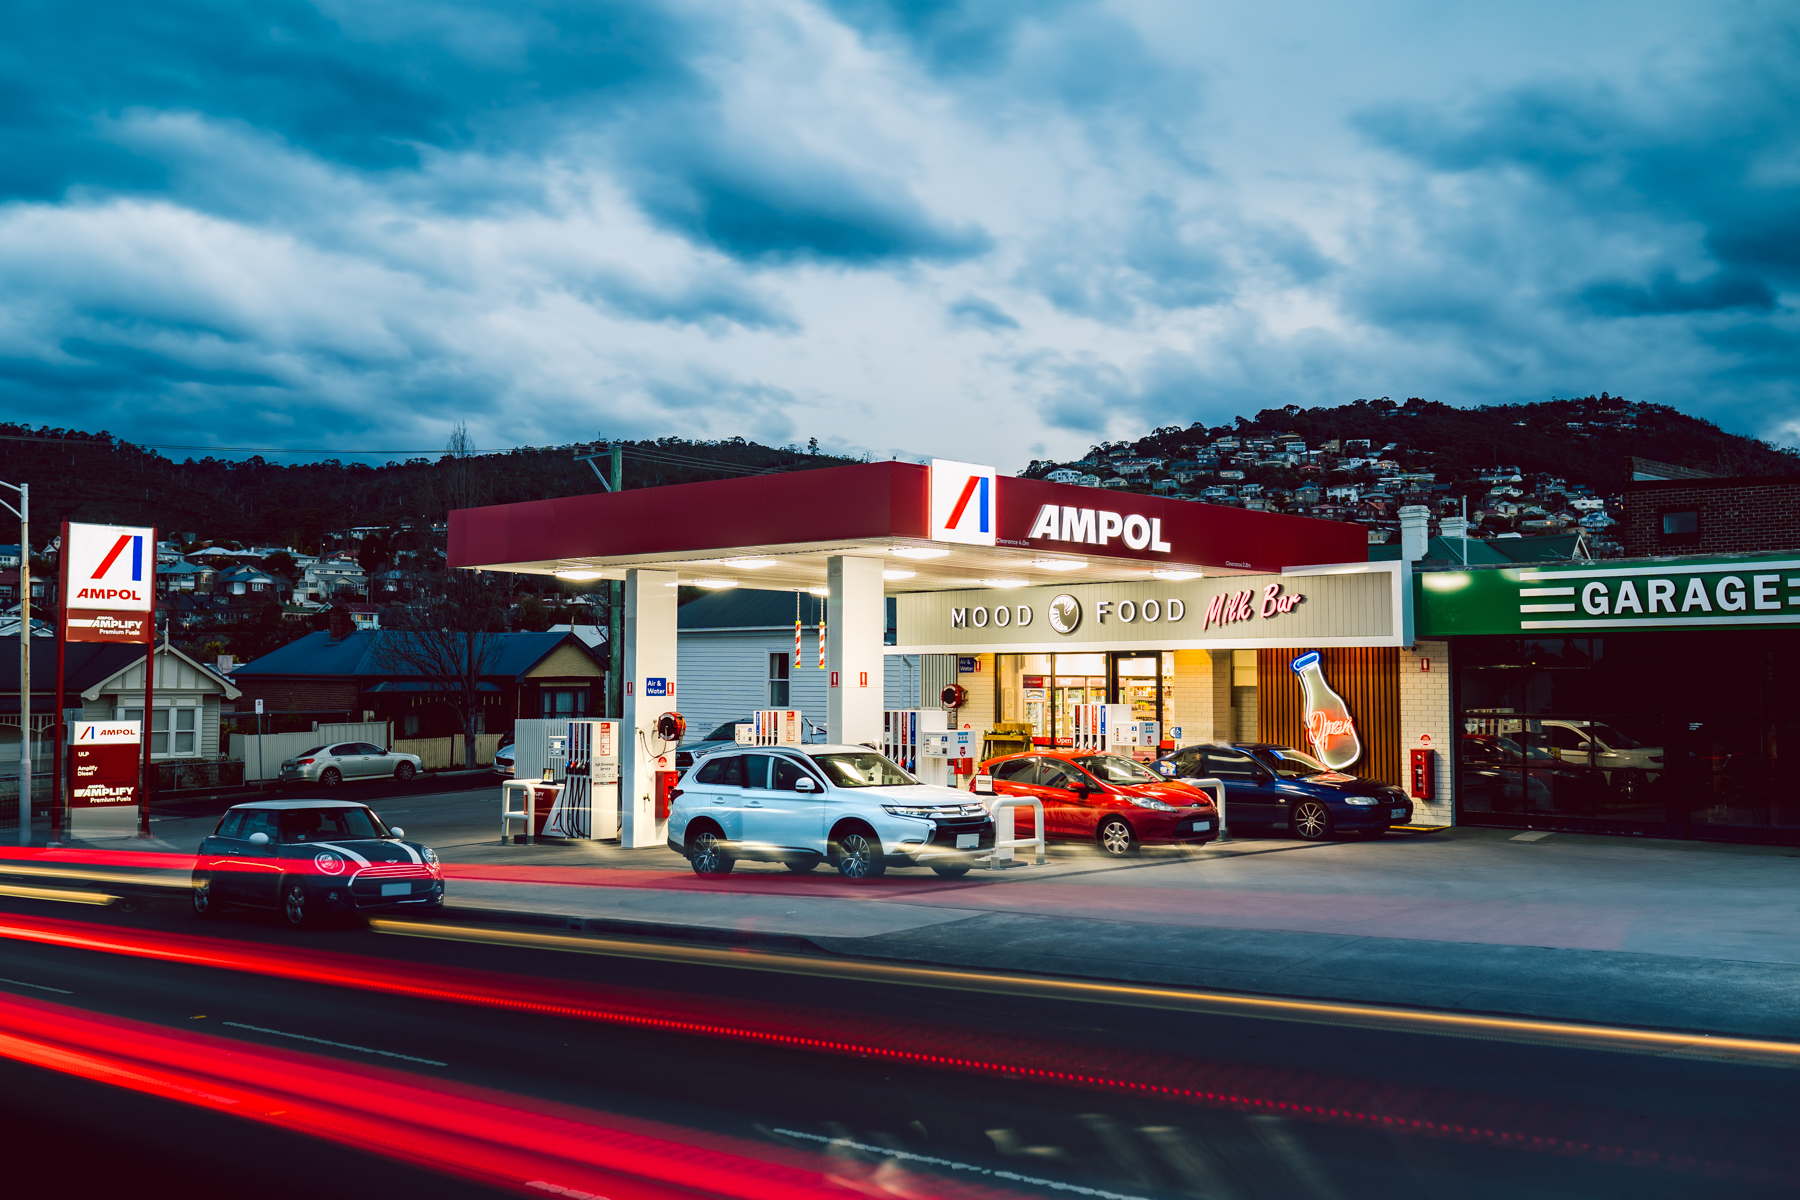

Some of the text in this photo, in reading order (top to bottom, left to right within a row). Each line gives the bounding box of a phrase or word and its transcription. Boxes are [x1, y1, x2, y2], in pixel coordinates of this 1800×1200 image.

[1027, 504, 1171, 553] AMPOL
[995, 537, 1018, 545] Clearance
[76, 588, 141, 601] AMPOL
[1581, 574, 1782, 616] GARAGE
[951, 598, 1185, 628] MOOD FOOD
[1202, 583, 1302, 630] Milk Bar
[91, 620, 143, 629] AMPLIFY
[1056, 737, 1072, 745] Open
[1306, 710, 1352, 751] Open
[82, 787, 135, 797] AMPLIFY
